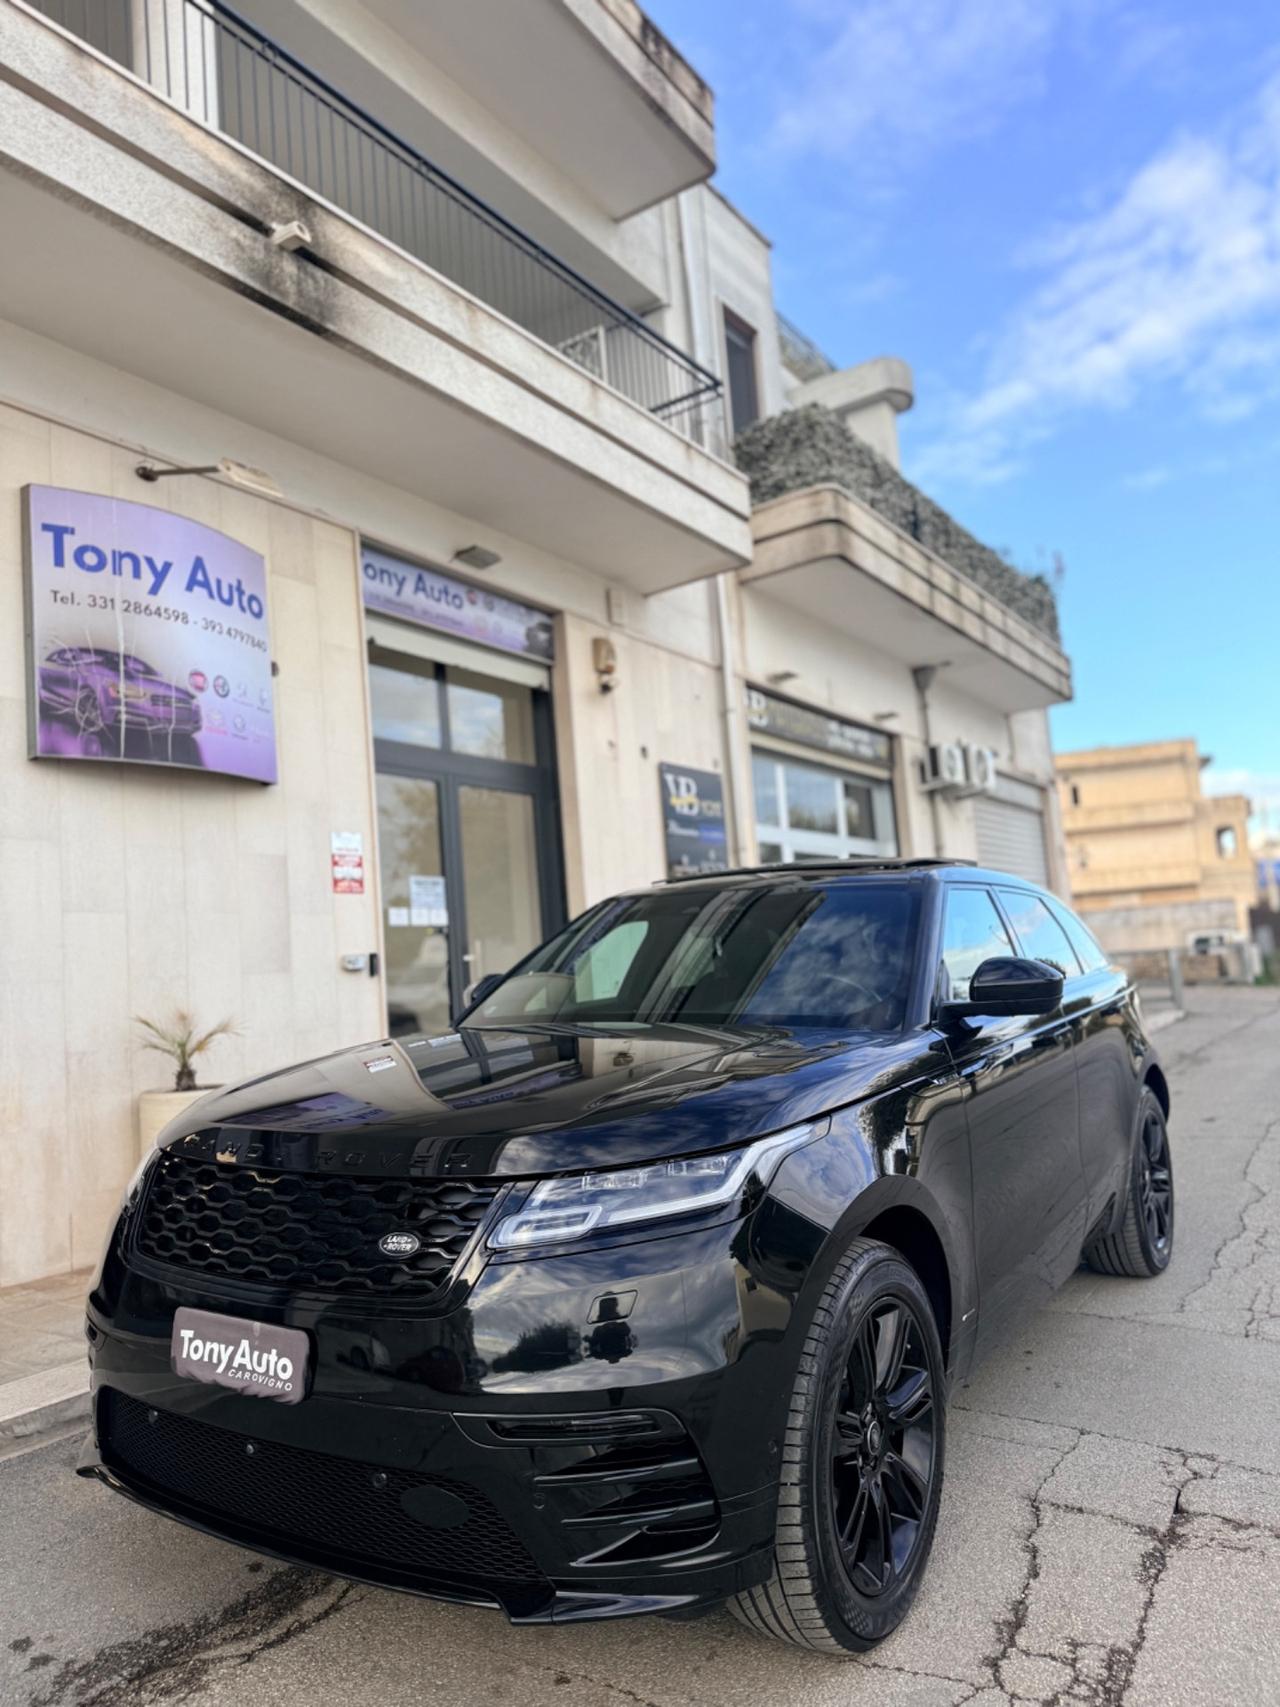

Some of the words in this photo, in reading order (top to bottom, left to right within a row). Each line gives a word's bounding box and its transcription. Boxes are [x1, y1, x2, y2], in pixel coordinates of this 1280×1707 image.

[41, 522, 173, 596] Tony
[185, 555, 264, 620] Auto
[361, 559, 406, 597] ony
[414, 572, 464, 610] Auto
[50, 589, 81, 606] Tel.
[87, 593, 115, 610] 331
[121, 599, 190, 626] 2864598
[201, 617, 224, 635] 393
[228, 1368, 293, 1392] CAROVIGNO
